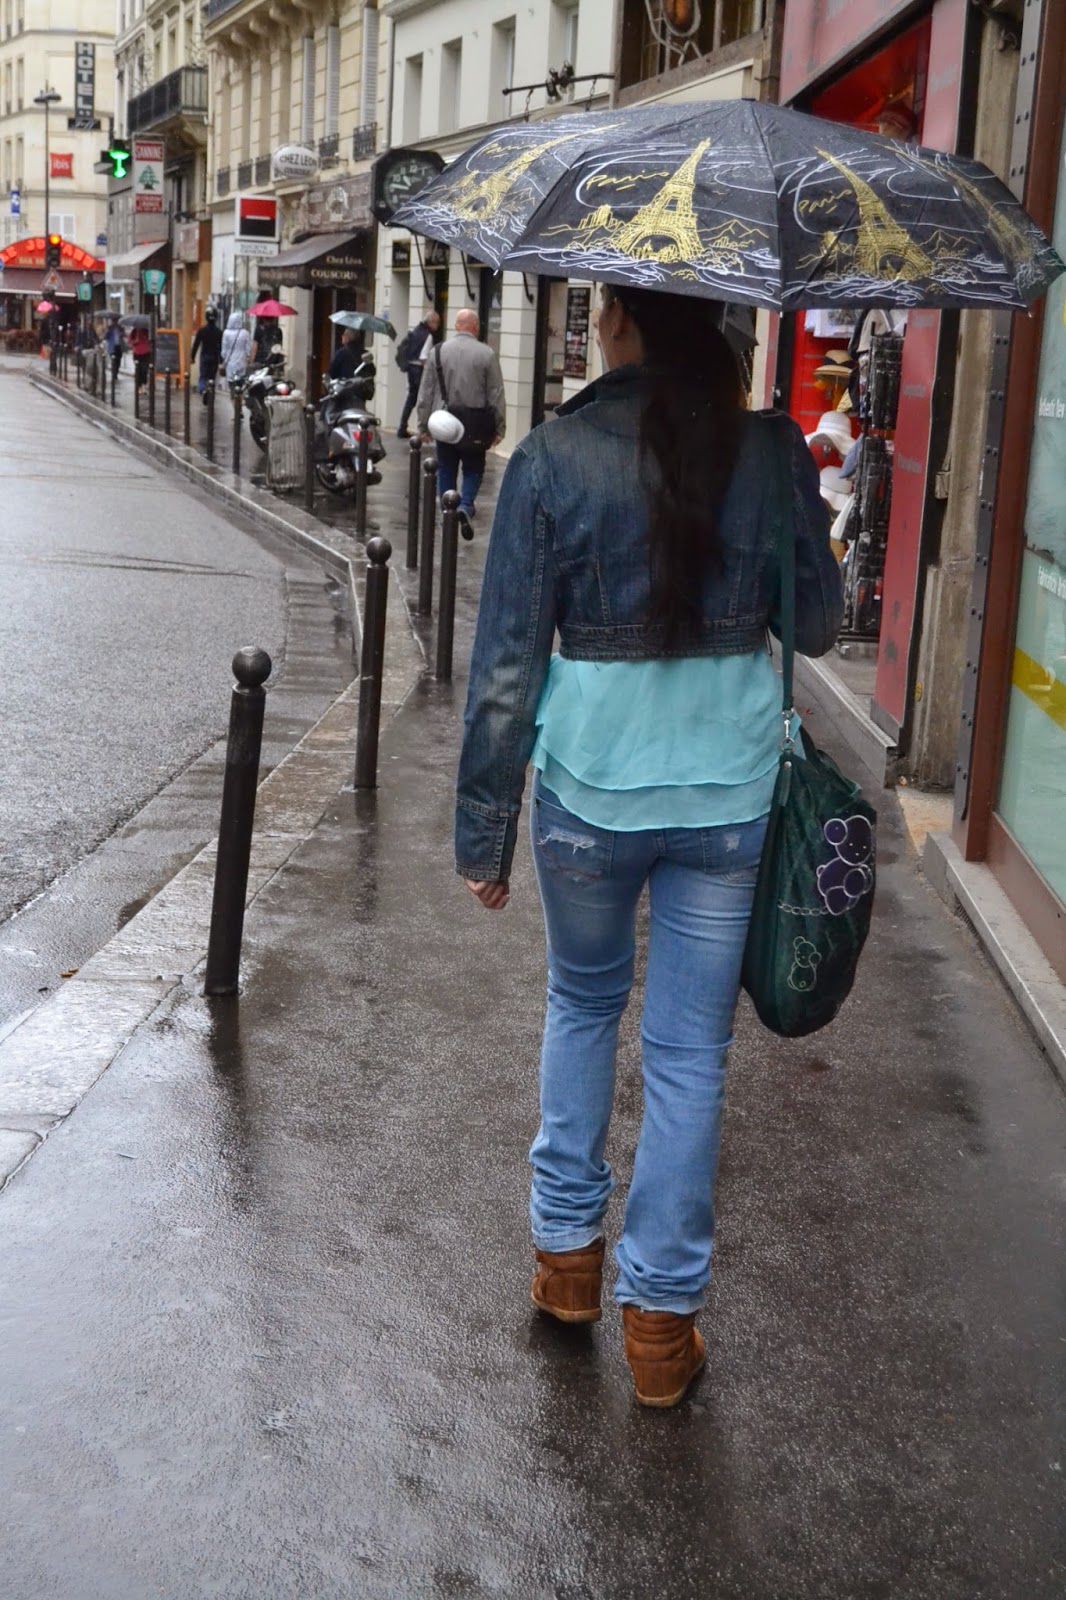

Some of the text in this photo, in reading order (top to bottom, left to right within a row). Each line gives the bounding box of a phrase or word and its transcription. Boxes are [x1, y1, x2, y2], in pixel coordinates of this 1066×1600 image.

[77, 42, 94, 109] HOTEL
[52, 159, 70, 169] ibis
[279, 153, 299, 165] CHEZ
[586, 169, 670, 191] Paris
[798, 189, 853, 218] Paris
[310, 268, 358, 280] COUSCOUS
